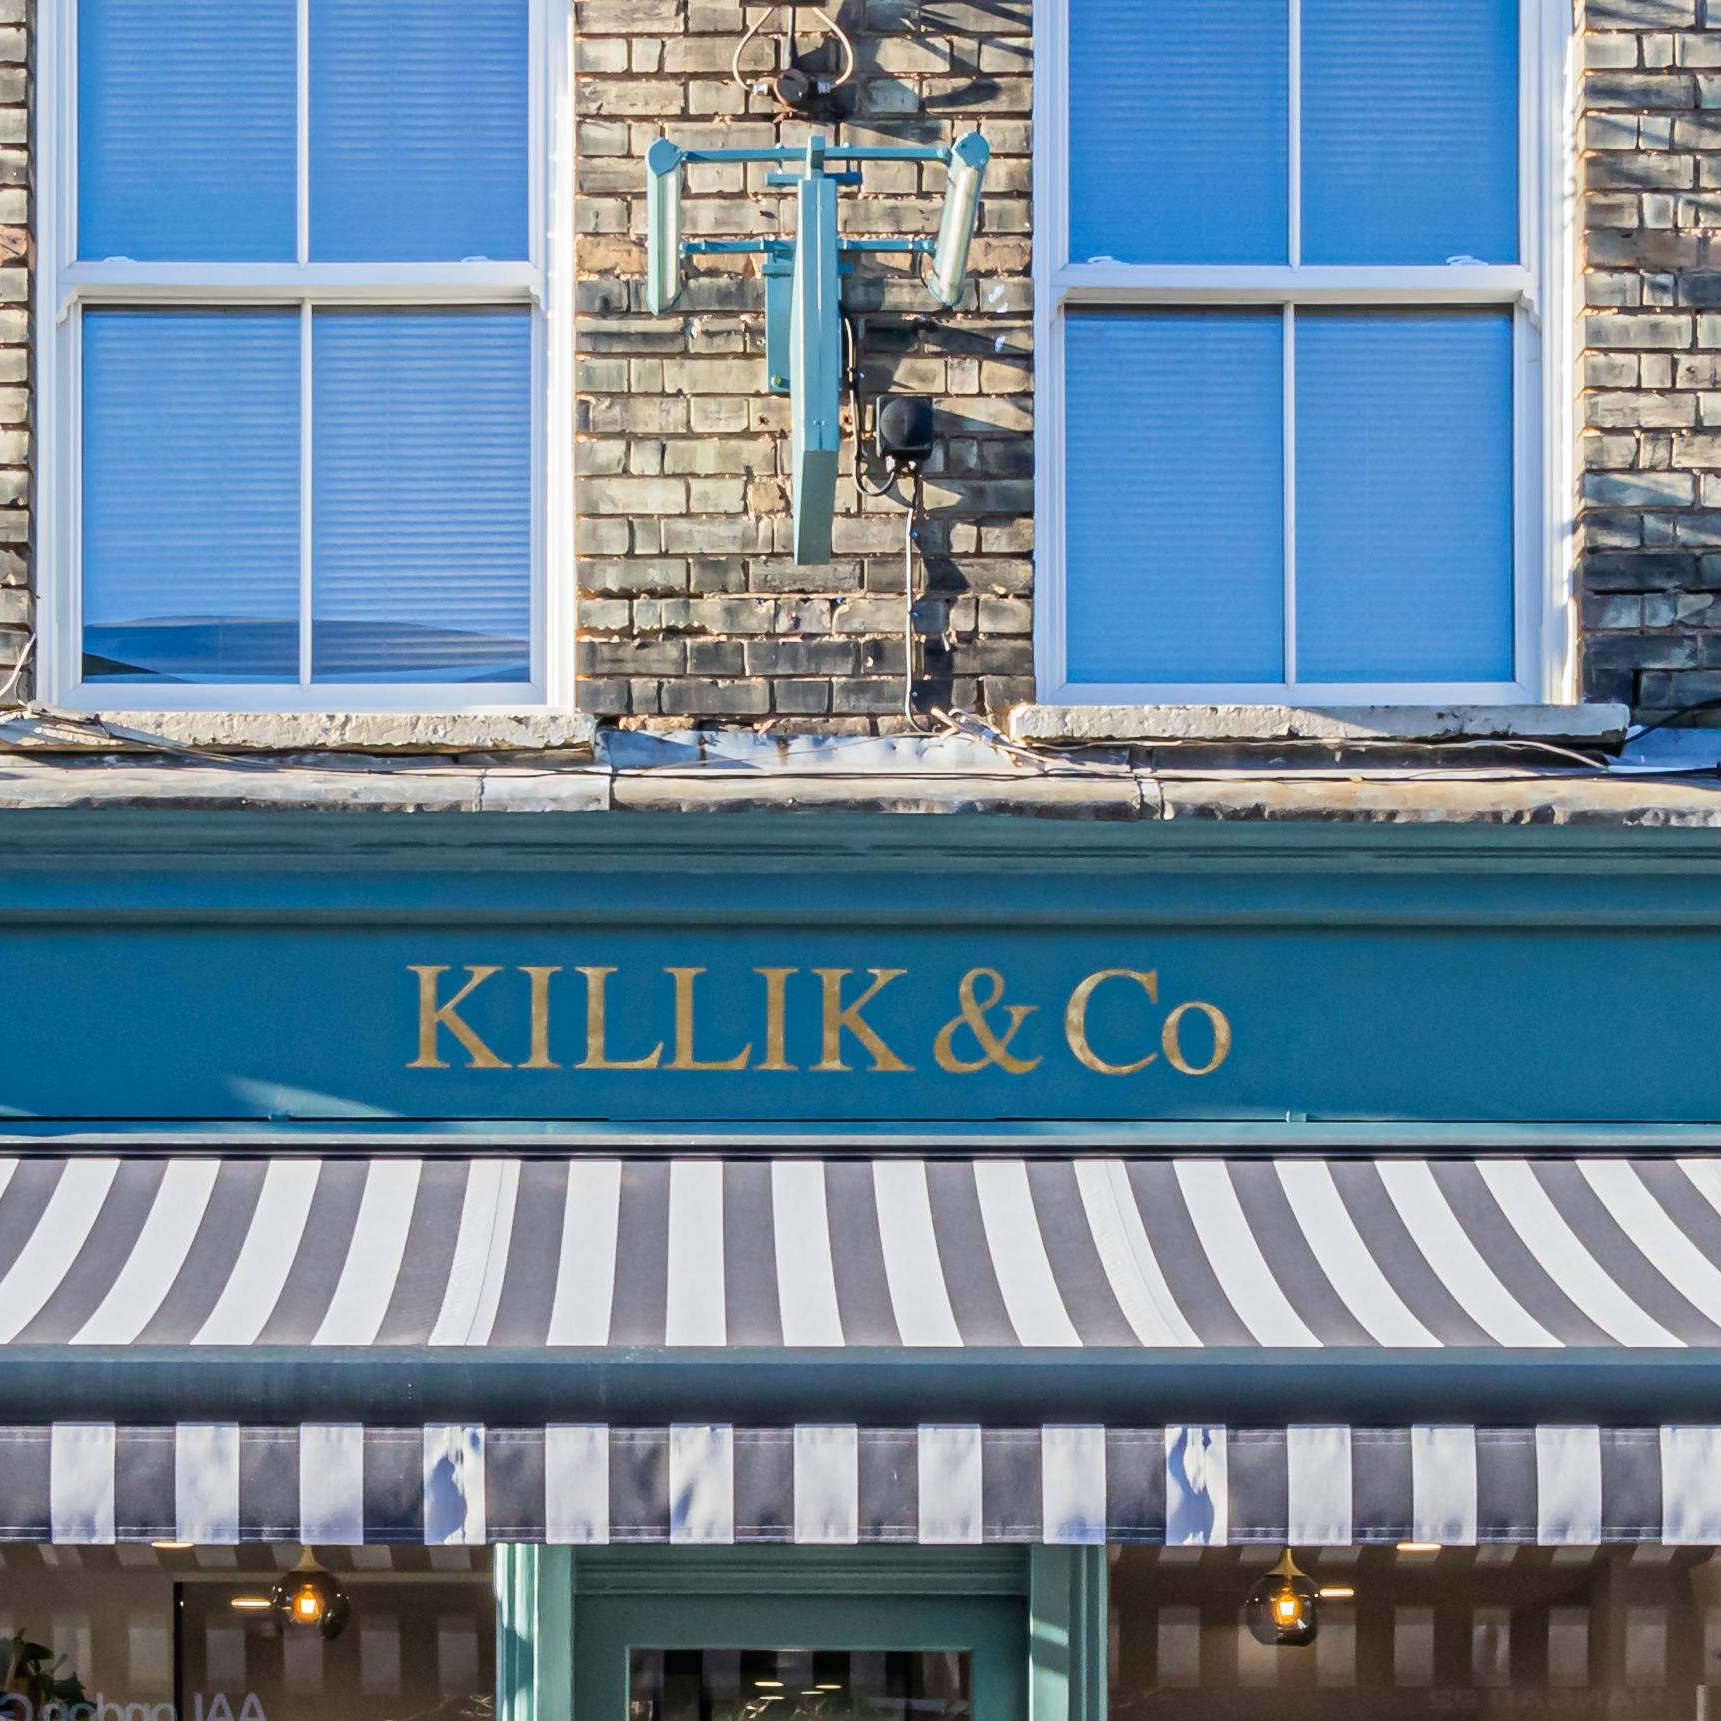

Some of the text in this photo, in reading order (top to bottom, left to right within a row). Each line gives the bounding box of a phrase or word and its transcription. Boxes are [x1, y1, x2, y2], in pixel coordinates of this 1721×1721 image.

[405, 964, 1233, 1076] KILLIK & Co
